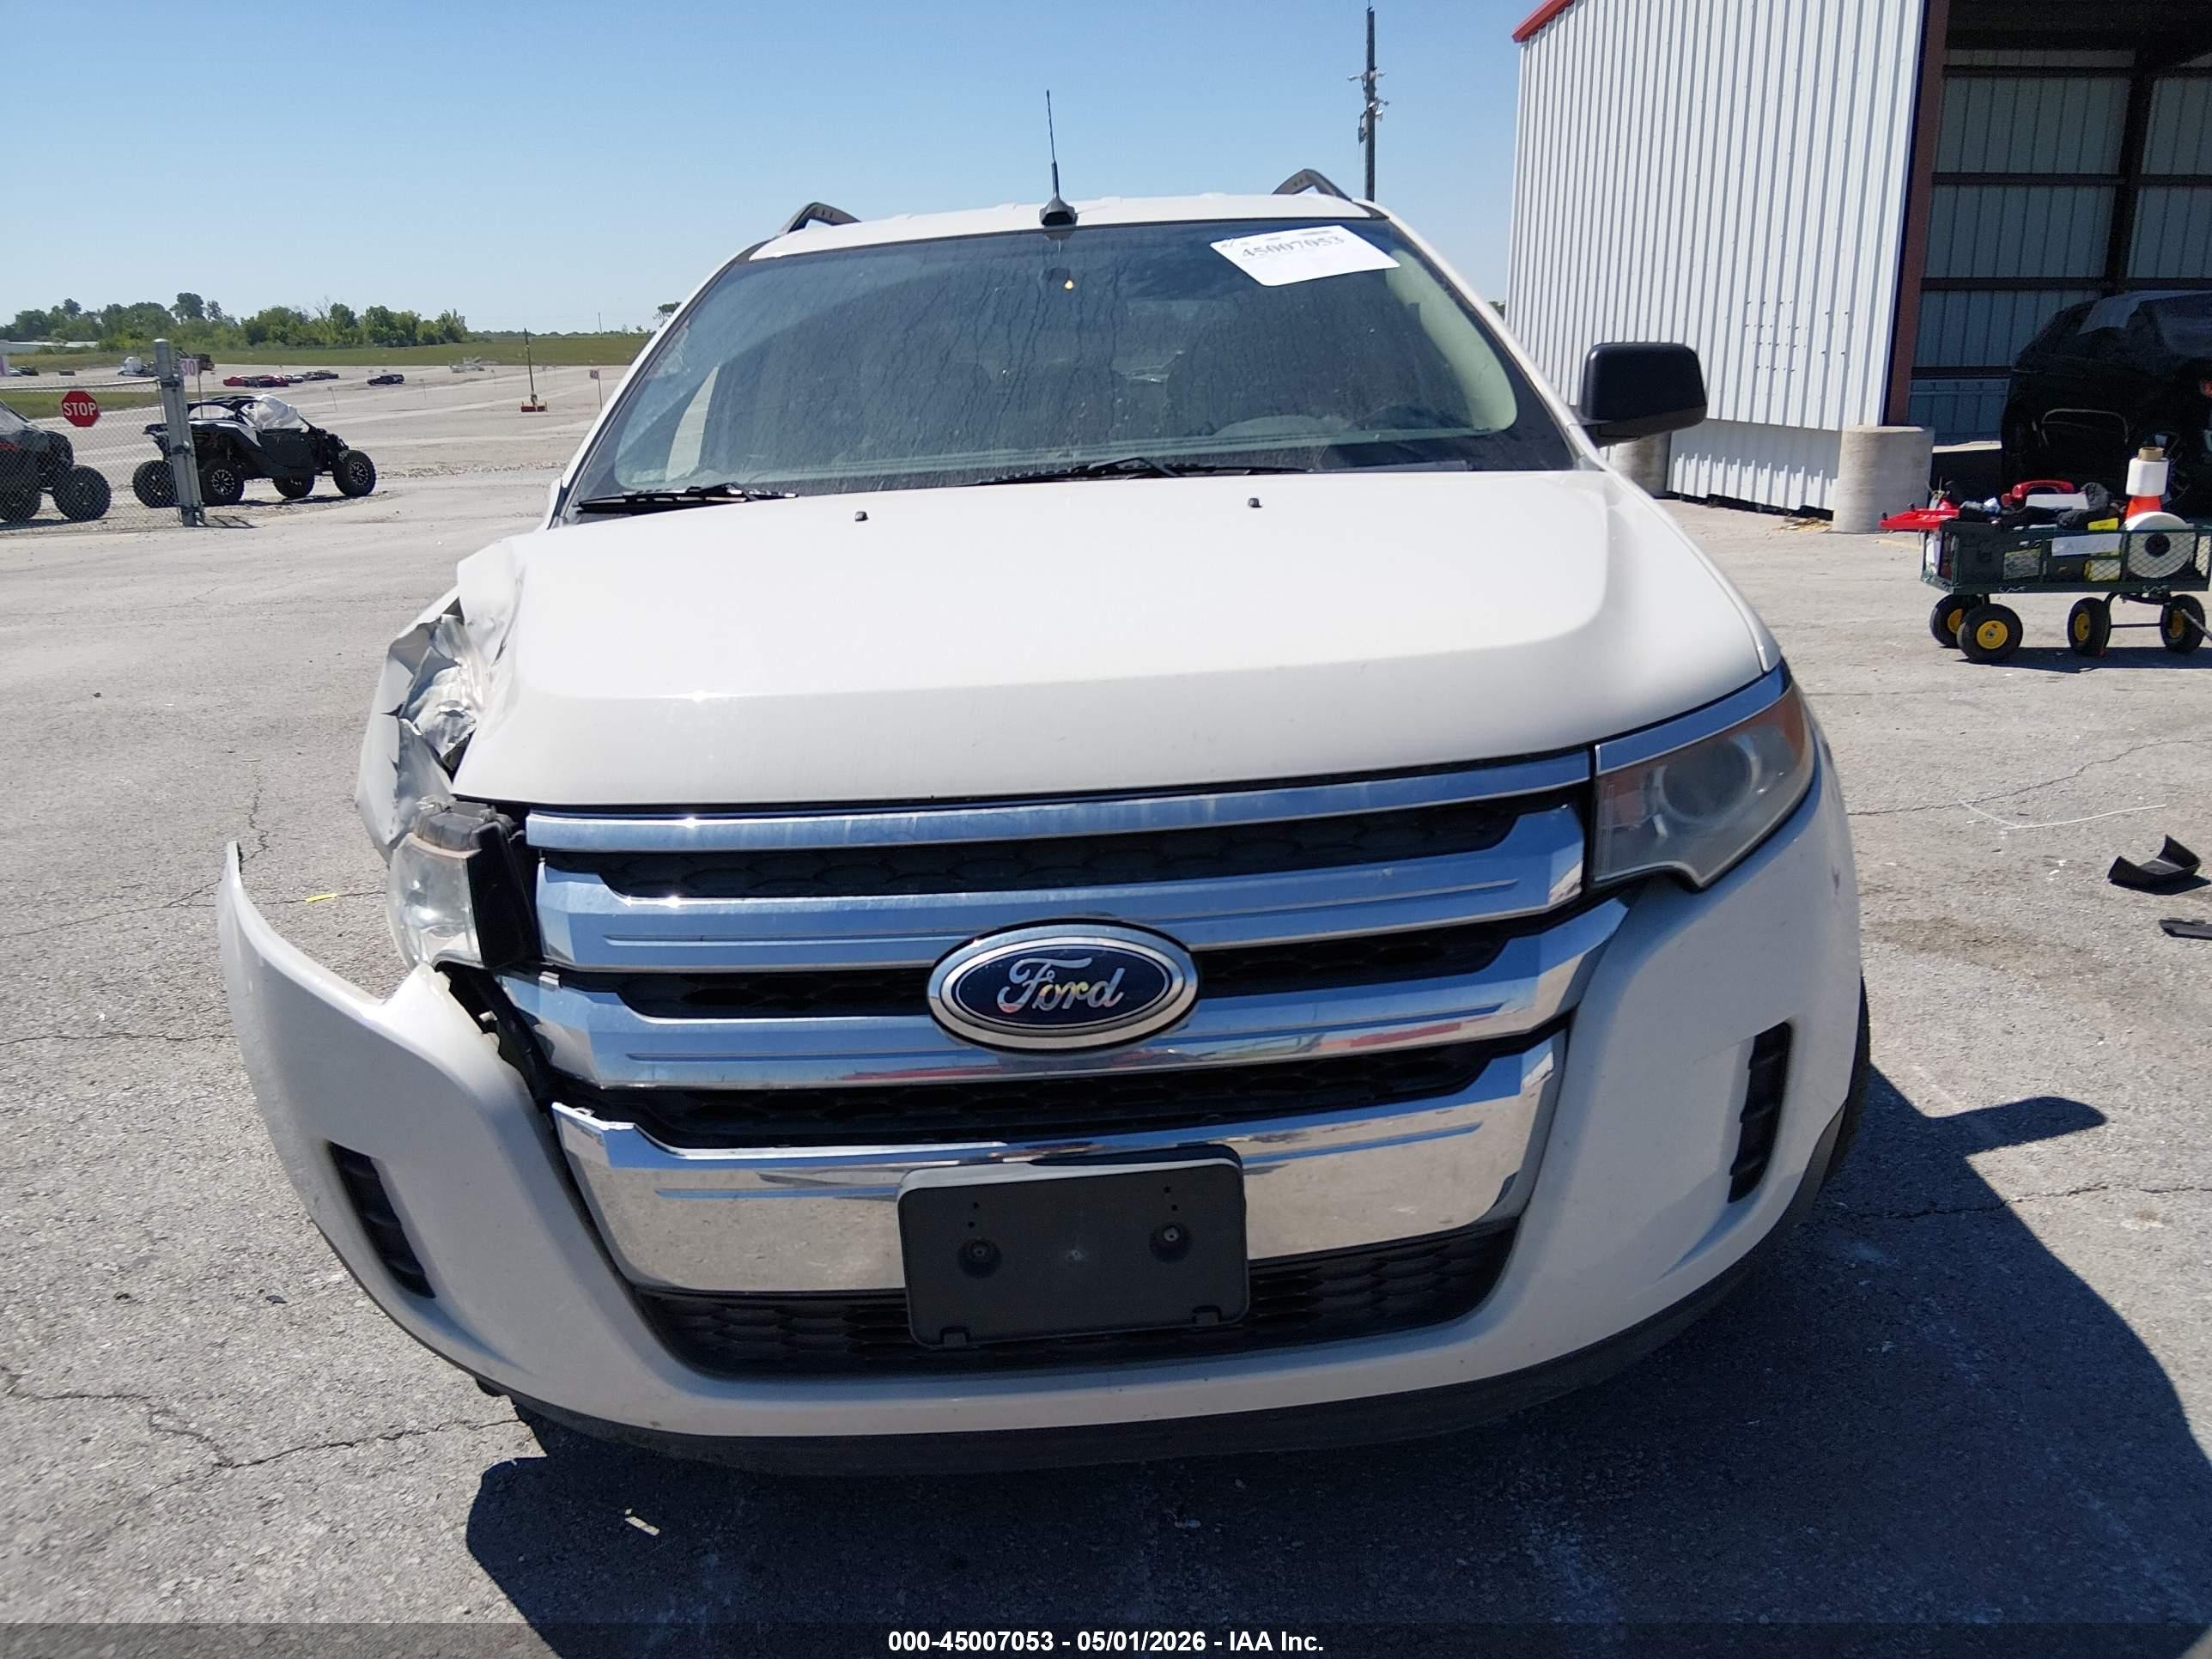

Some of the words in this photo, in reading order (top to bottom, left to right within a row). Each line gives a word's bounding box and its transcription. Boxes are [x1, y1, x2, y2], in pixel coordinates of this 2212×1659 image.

[1243, 236, 1345, 258] 45007053
[63, 402, 97, 416] STOP
[997, 957, 1125, 1013] Ford
